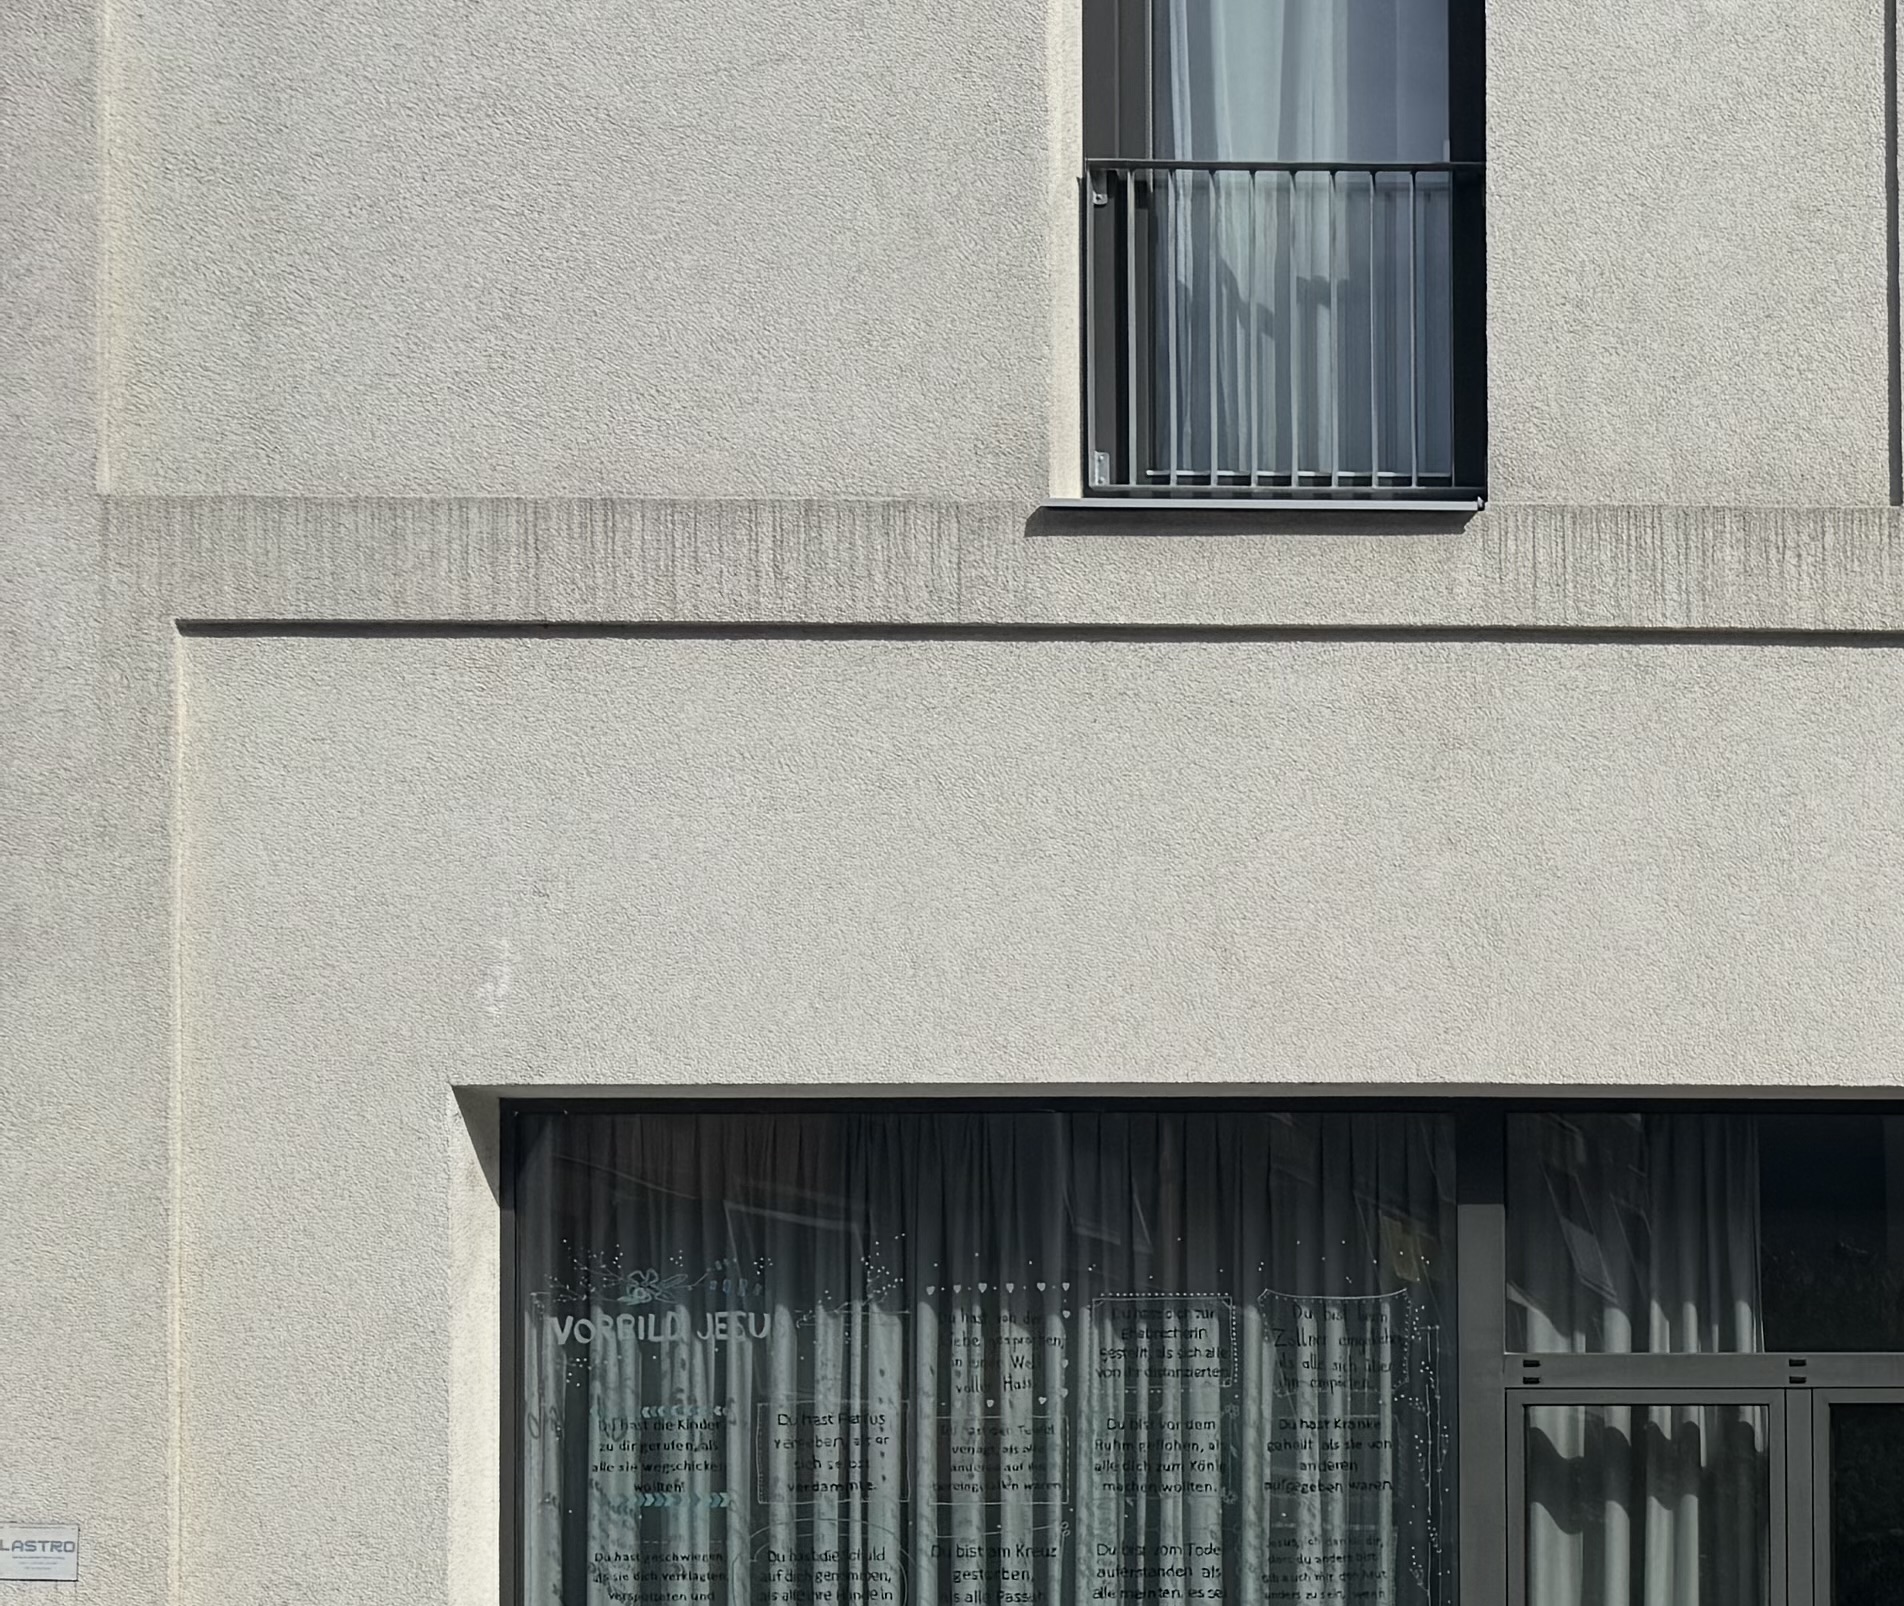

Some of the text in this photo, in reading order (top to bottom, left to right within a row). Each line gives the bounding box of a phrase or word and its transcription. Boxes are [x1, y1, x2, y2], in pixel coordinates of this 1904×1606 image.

[552, 1310, 771, 1344] VORBILD JESU
[678, 1419, 721, 1431] Kinder
